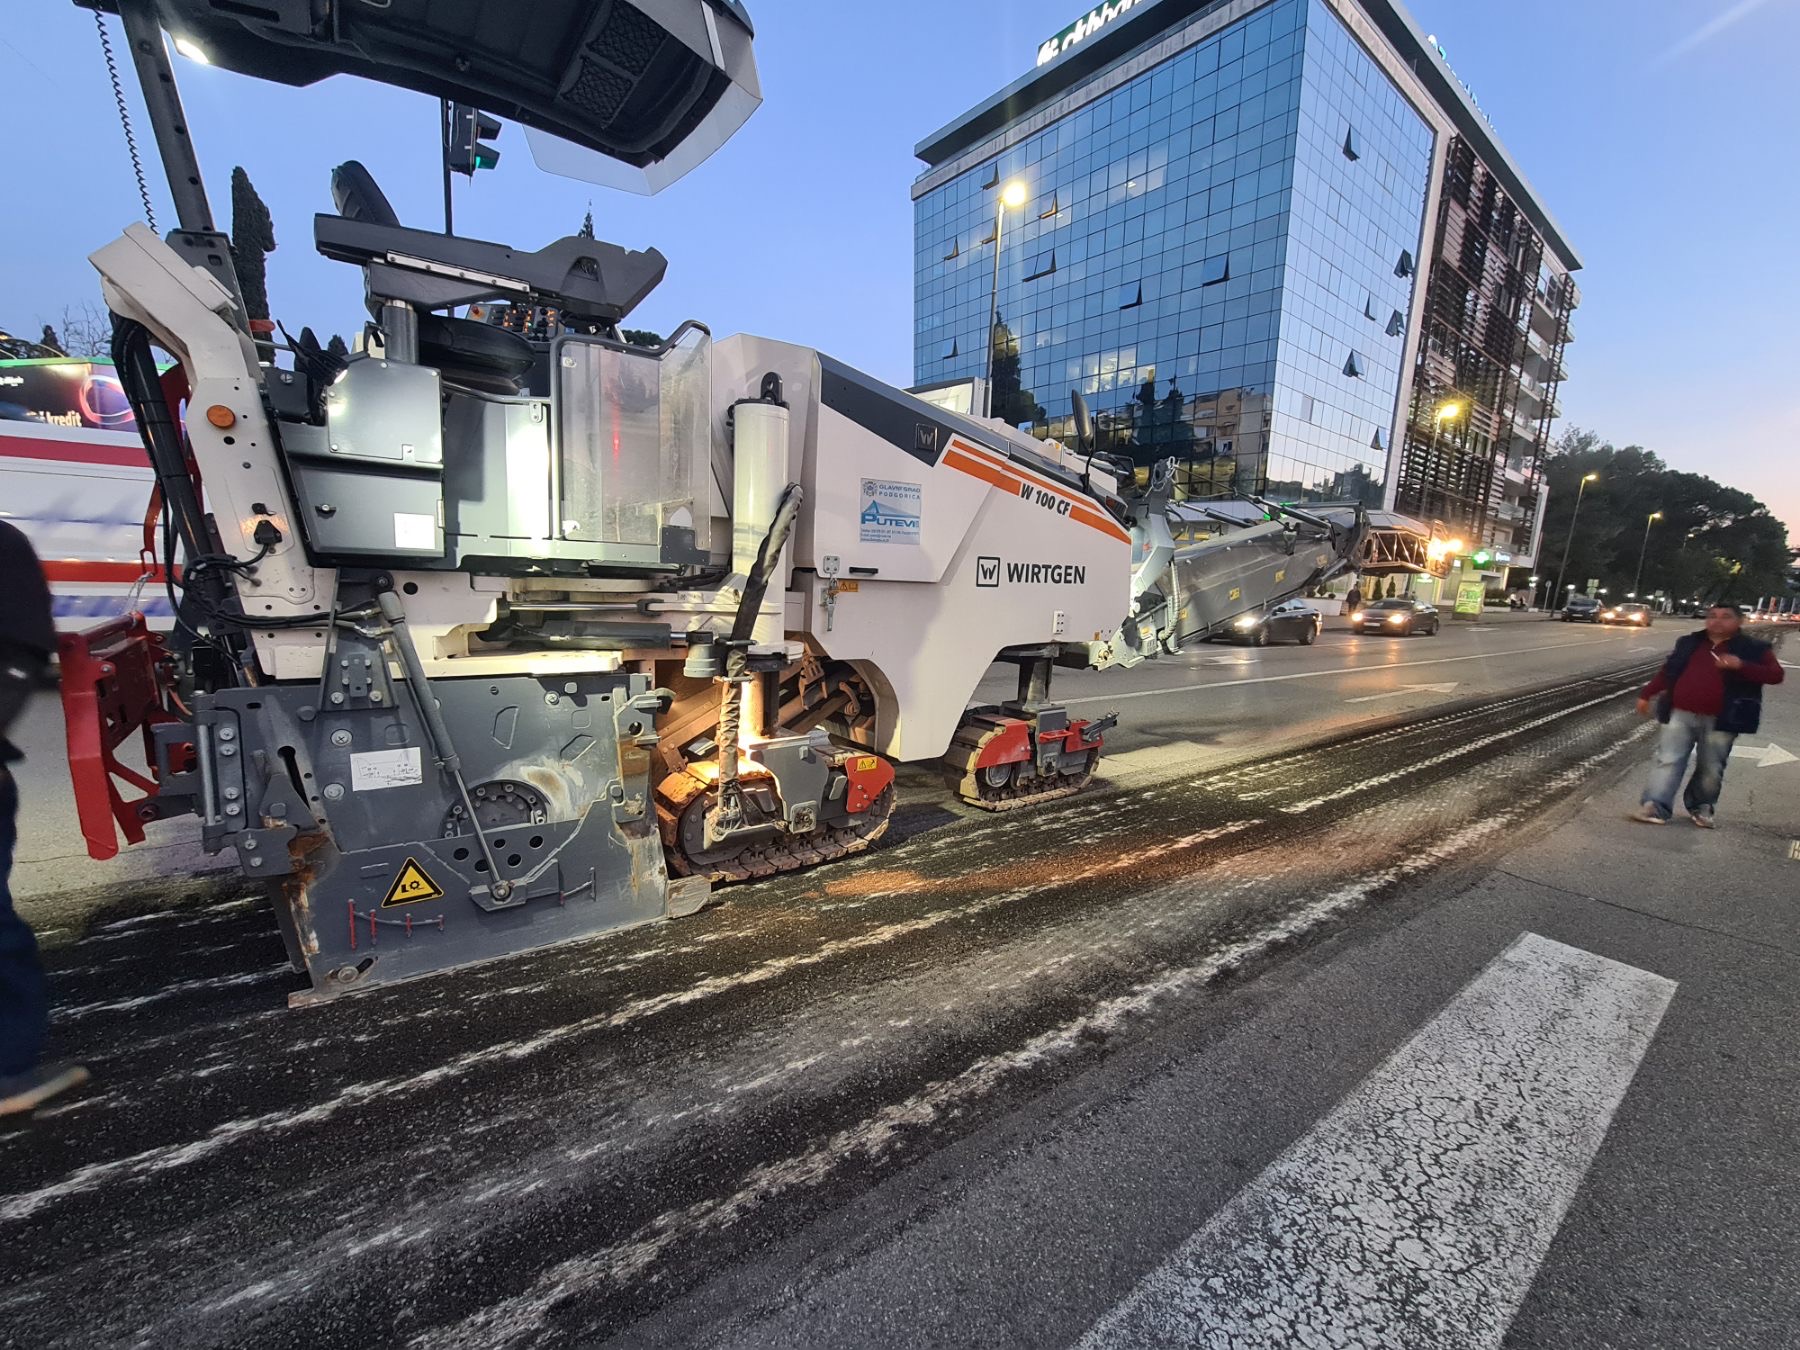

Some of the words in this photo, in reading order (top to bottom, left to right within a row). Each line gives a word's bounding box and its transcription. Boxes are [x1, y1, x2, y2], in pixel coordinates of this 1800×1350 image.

[45, 410, 83, 427] kredit
[879, 491, 921, 500] PODGORICA
[1020, 483, 1034, 500] W
[1035, 490, 1056, 510] 100
[1057, 500, 1071, 516] CF
[861, 512, 915, 528] PUTEVI
[1007, 562, 1086, 584] WIRTGEN
